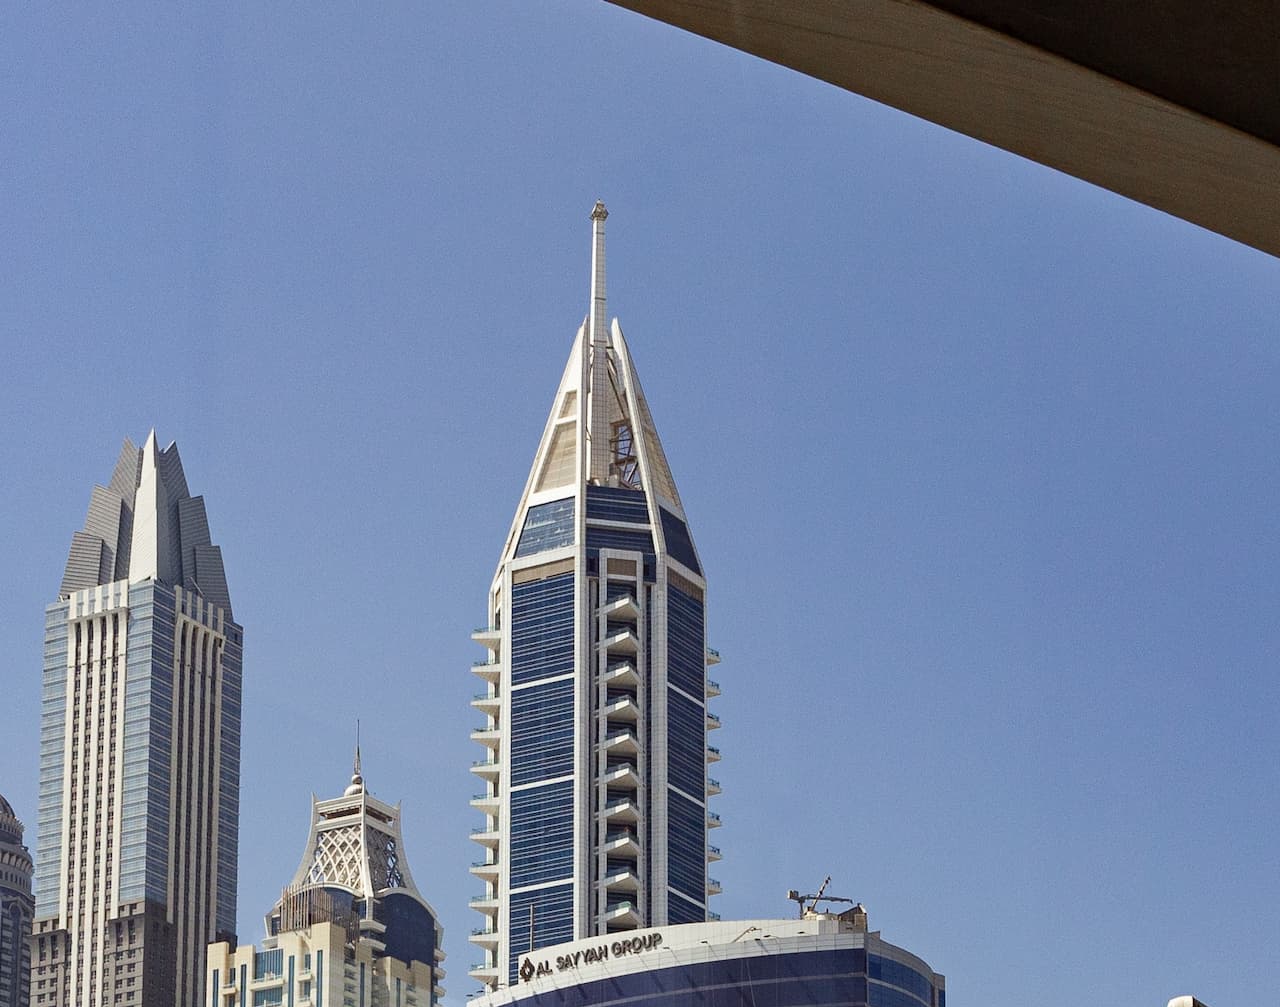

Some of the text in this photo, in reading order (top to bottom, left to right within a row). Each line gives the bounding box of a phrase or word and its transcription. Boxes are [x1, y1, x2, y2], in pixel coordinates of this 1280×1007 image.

[537, 933, 663, 977] AL SAYYAH GROUP
